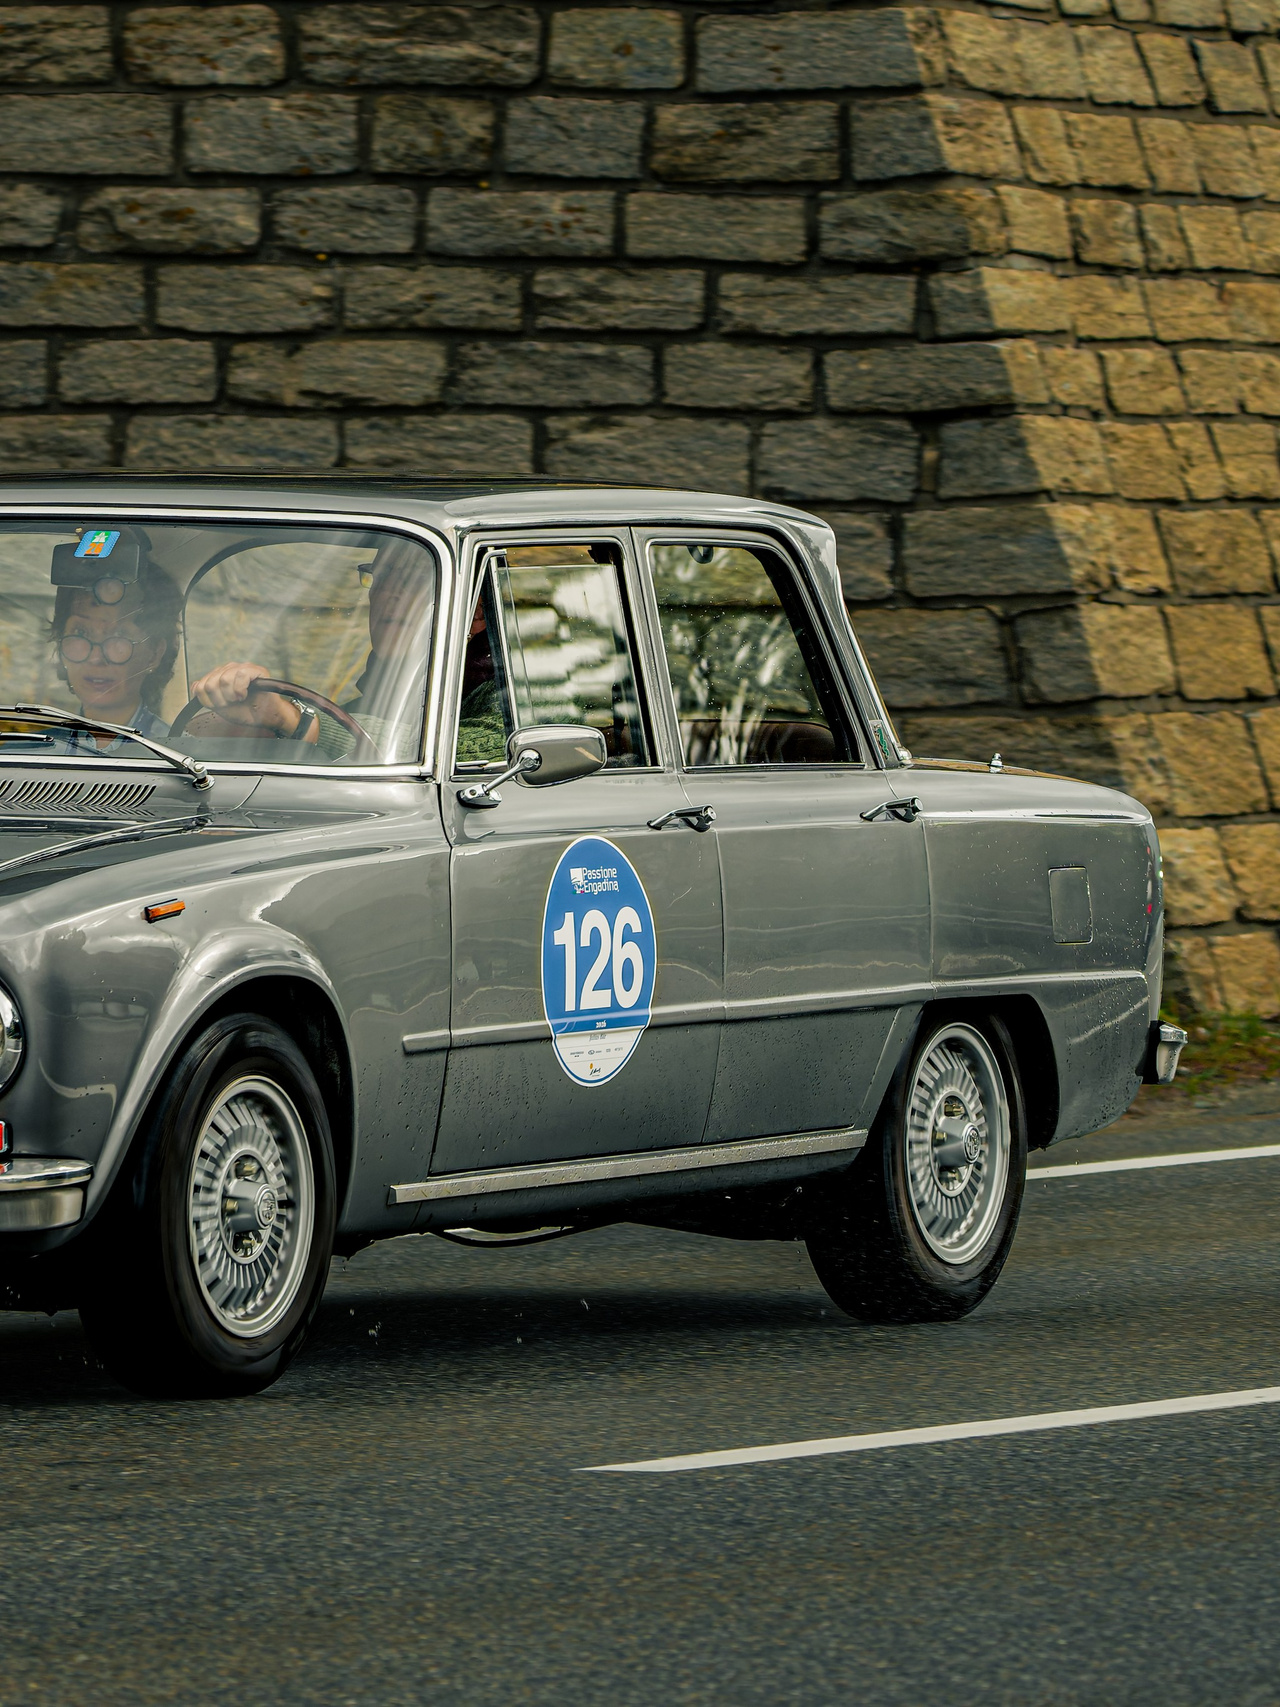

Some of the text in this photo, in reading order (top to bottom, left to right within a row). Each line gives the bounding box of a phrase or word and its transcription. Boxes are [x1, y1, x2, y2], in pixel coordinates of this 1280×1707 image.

[84, 542, 104, 555] 26
[582, 866, 618, 879] Passione
[583, 879, 619, 895] Engadina
[553, 906, 644, 1012] 126
